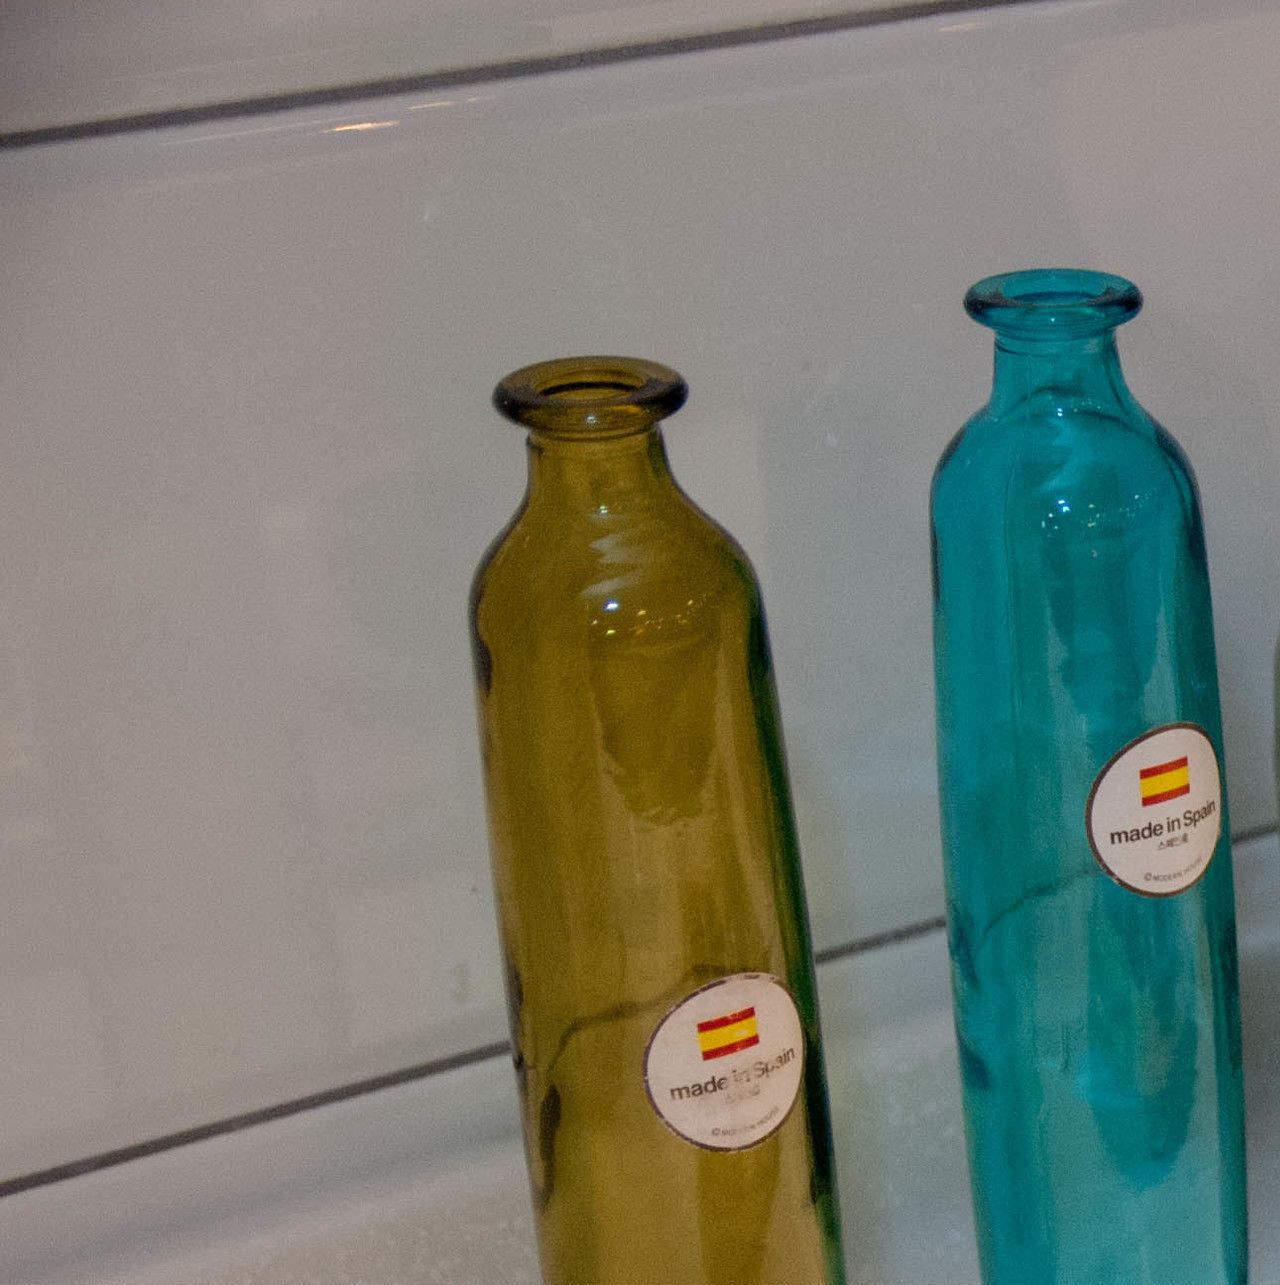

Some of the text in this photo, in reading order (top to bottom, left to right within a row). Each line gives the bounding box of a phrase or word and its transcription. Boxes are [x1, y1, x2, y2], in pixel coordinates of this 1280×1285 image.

[1110, 822, 1163, 845] made
[1167, 816, 1181, 834] in
[1183, 800, 1216, 829] Spain
[670, 1075, 729, 1100] made
[753, 1046, 795, 1078] Spain
